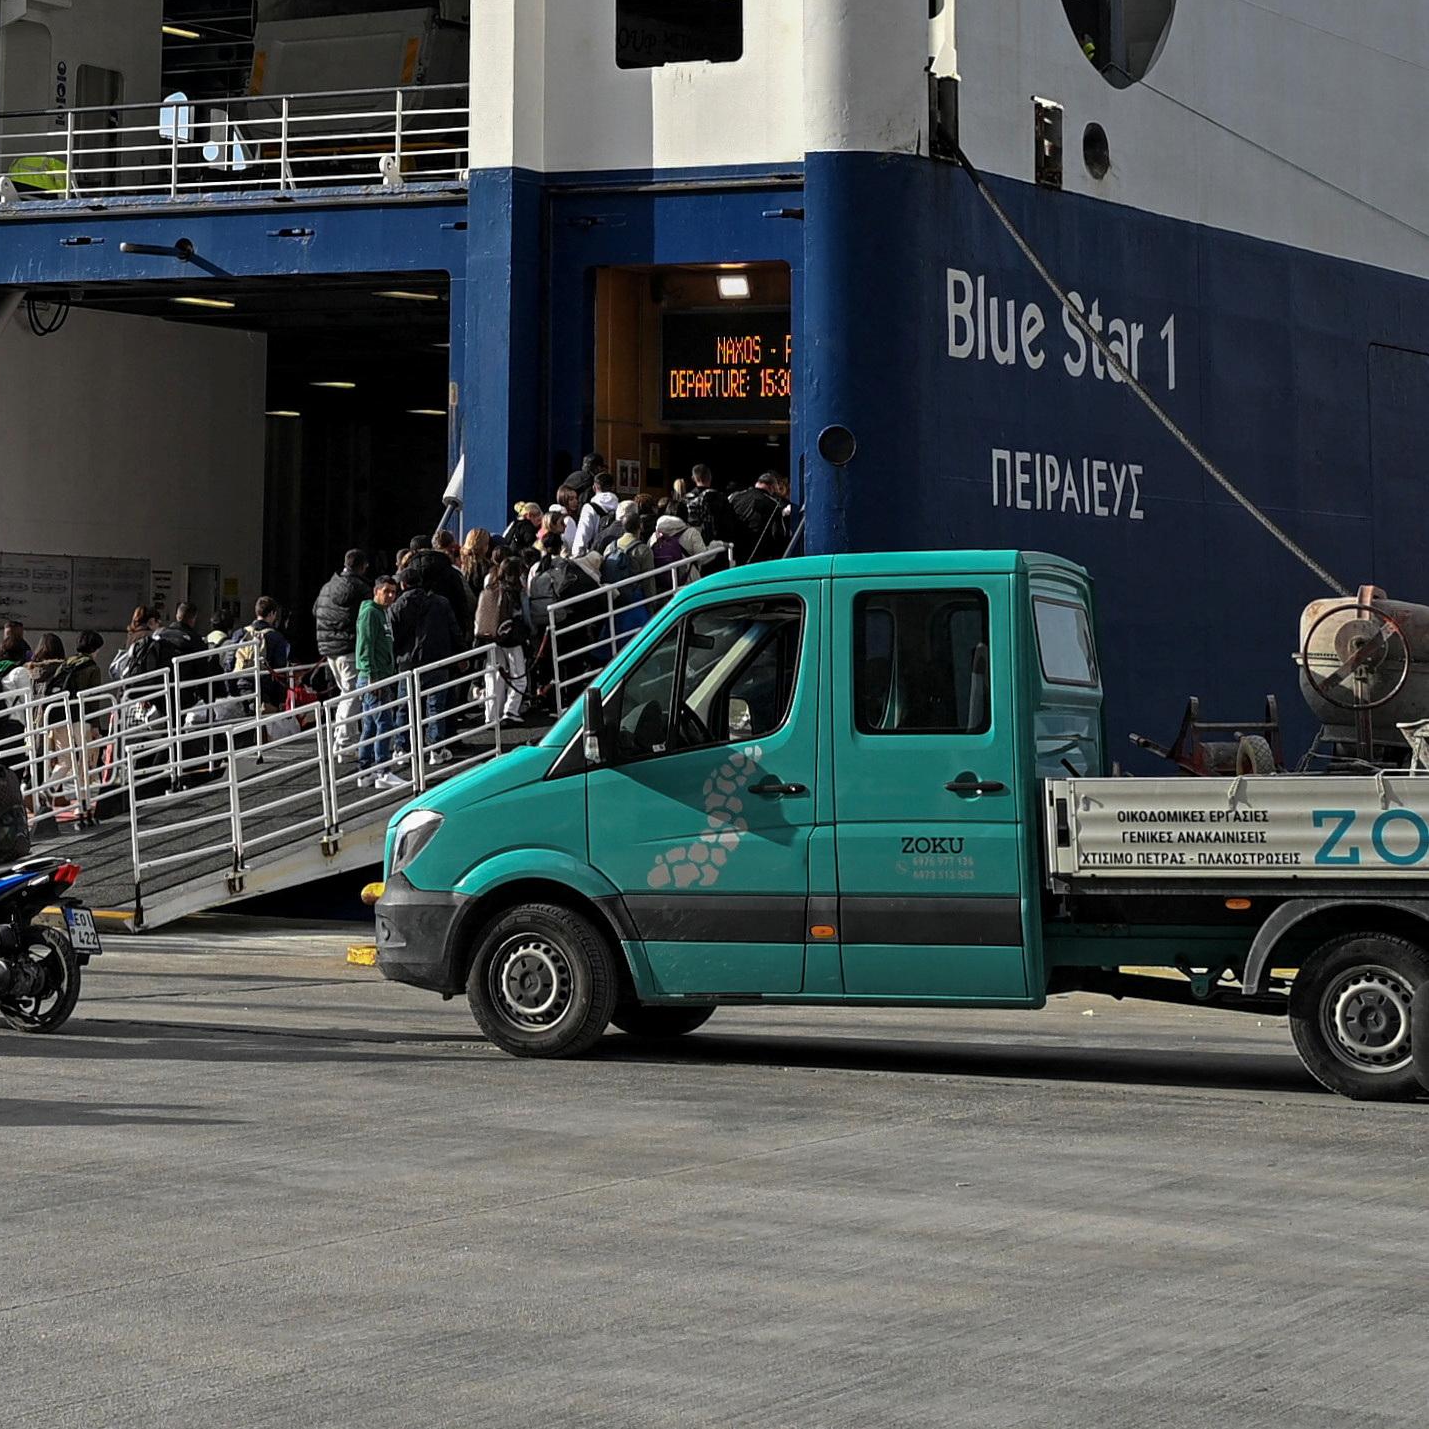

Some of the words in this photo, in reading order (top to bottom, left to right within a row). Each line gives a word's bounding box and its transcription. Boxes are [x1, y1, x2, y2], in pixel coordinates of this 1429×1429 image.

[946, 267, 1046, 371] Blue
[1062, 290, 1144, 385] Star
[1159, 313, 1177, 391] 1
[716, 335, 762, 365] NAXOS
[670, 368, 751, 399] DEPARTURE:
[990, 446, 1145, 521] ΠΕΙΡΑΙΕΥΣ
[1117, 810, 1206, 823] ΟΙΚΟΔΟΜΙΚΕΣ
[1209, 810, 1269, 823] ΕΡΓΑΣΙΕΣ
[901, 837, 964, 854] ZOKU
[1122, 831, 1173, 844] ΓΕΝΙΚΕΣ
[1177, 831, 1267, 844] ΑΝΑΚΑΙΝΙΣΕΙΣ
[1312, 809, 1429, 866] ZO
[1082, 852, 1133, 865] ΧΤΙΣΙΜΟ
[1137, 852, 1186, 865] ΠΕΤΡΑΣ
[1198, 852, 1301, 865] ΠΛΑΚΟΣΤΡΩΣΕΙΣ
[78, 930, 97, 946] 422
